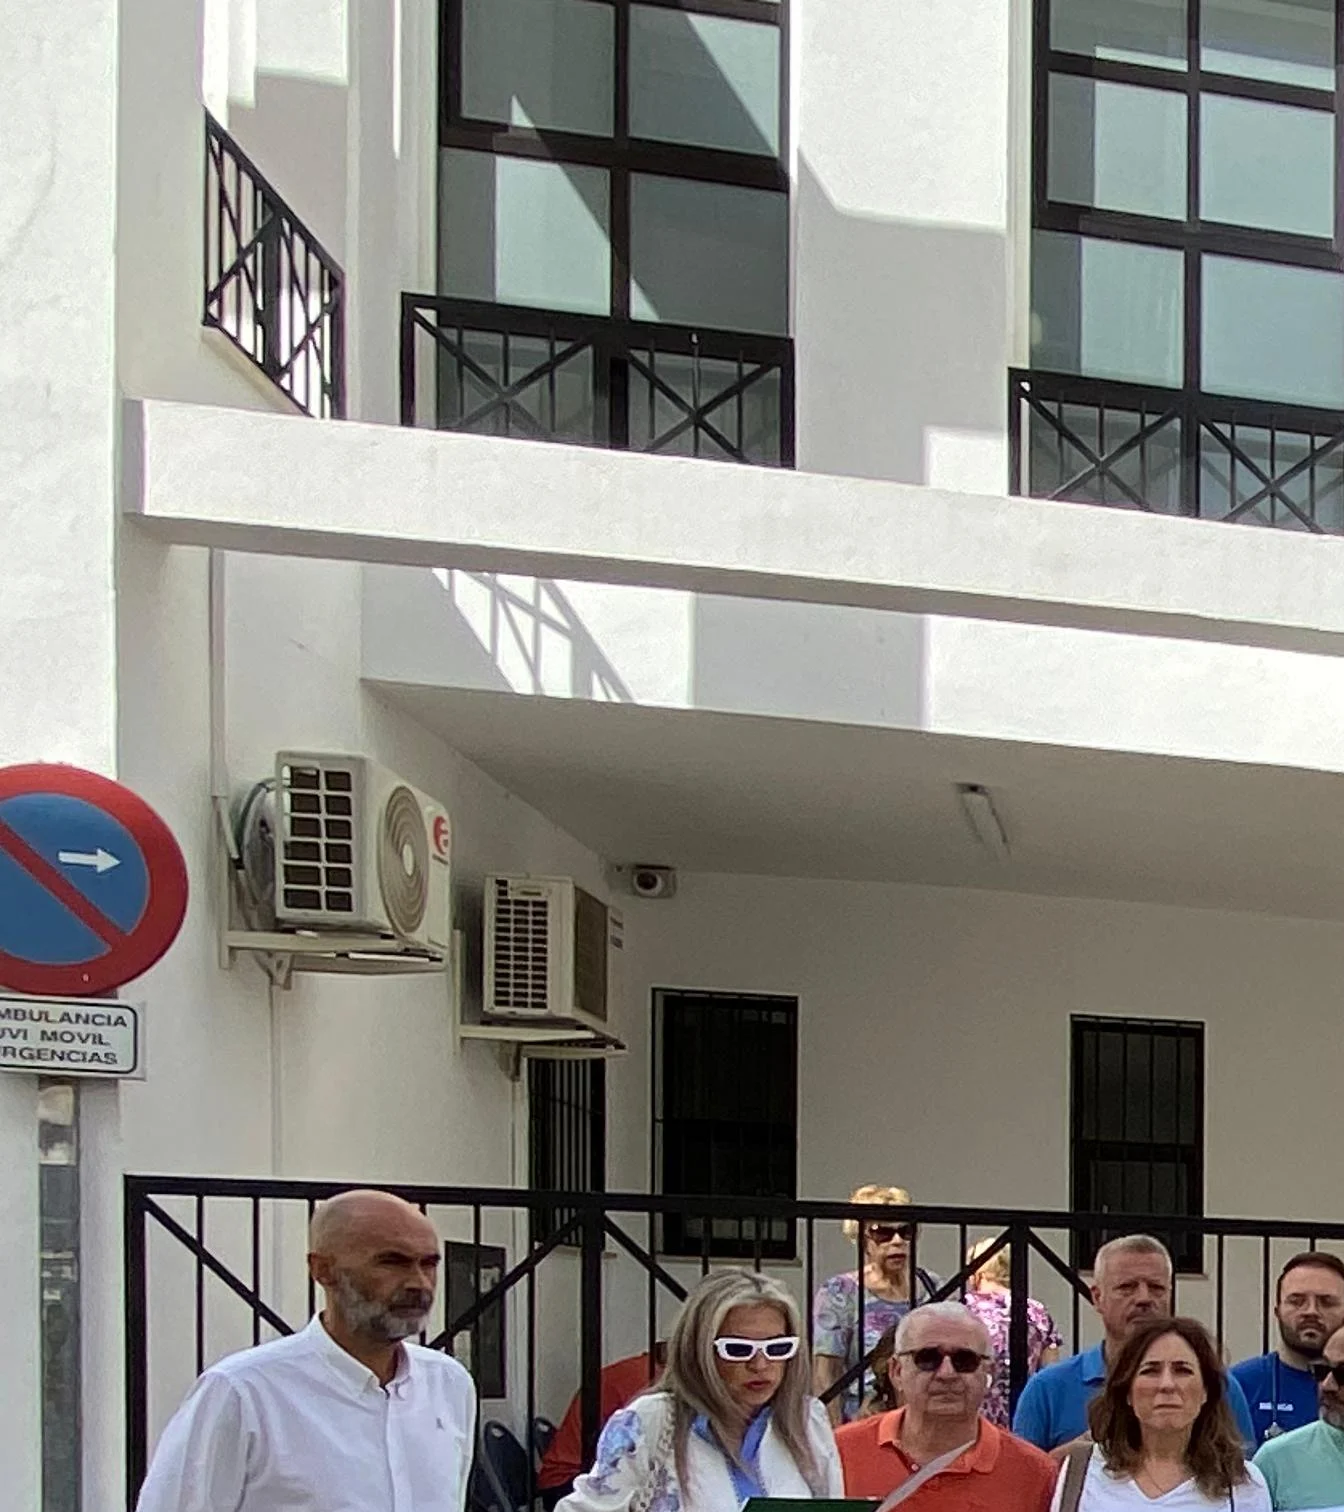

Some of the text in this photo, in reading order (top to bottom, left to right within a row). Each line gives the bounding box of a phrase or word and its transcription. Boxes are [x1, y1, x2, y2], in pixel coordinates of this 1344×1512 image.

[0, 1007, 127, 1028] MBULANCIA
[40, 1029, 111, 1046] MOVIL
[0, 1046, 118, 1065] RGENCIAS
